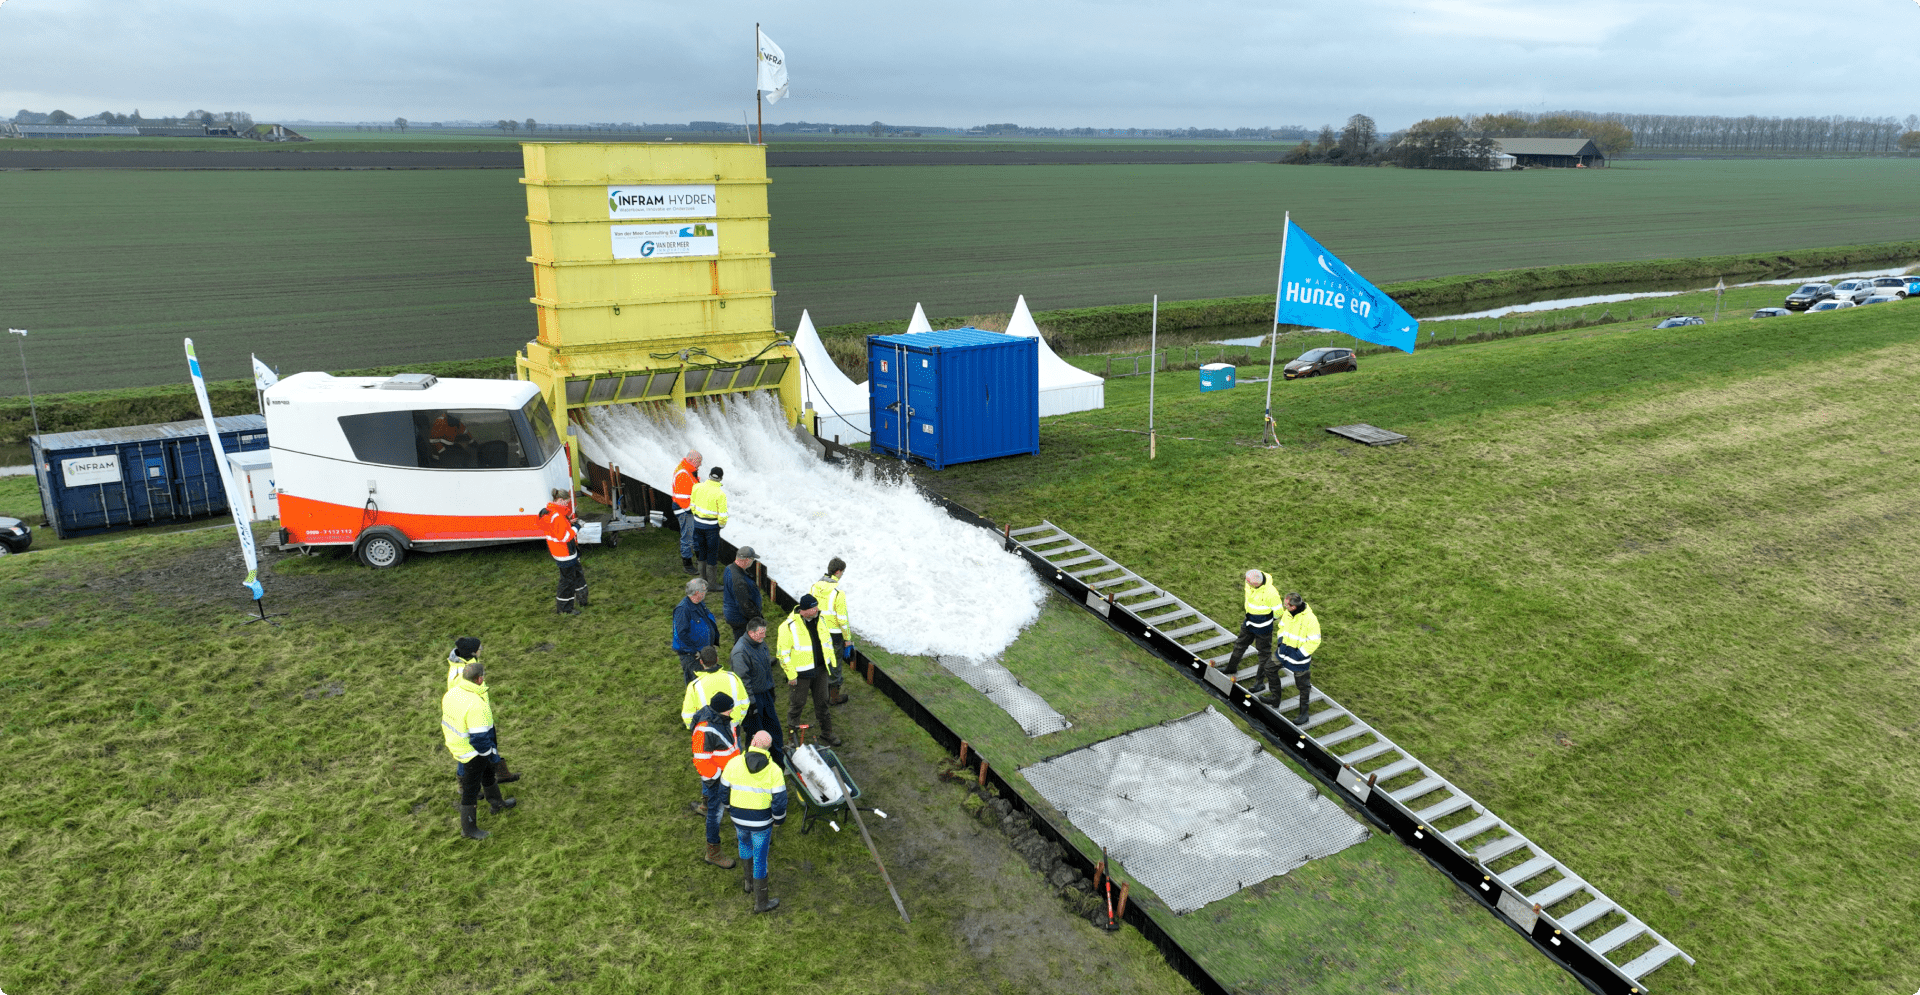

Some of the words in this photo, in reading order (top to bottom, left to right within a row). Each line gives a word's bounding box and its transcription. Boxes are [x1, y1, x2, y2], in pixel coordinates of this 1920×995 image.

[618, 195, 664, 206] INFRAM
[669, 194, 716, 205] HYDREN
[1286, 281, 1345, 309] Hunze
[1350, 297, 1371, 318] en
[75, 462, 114, 471] INFRAM
